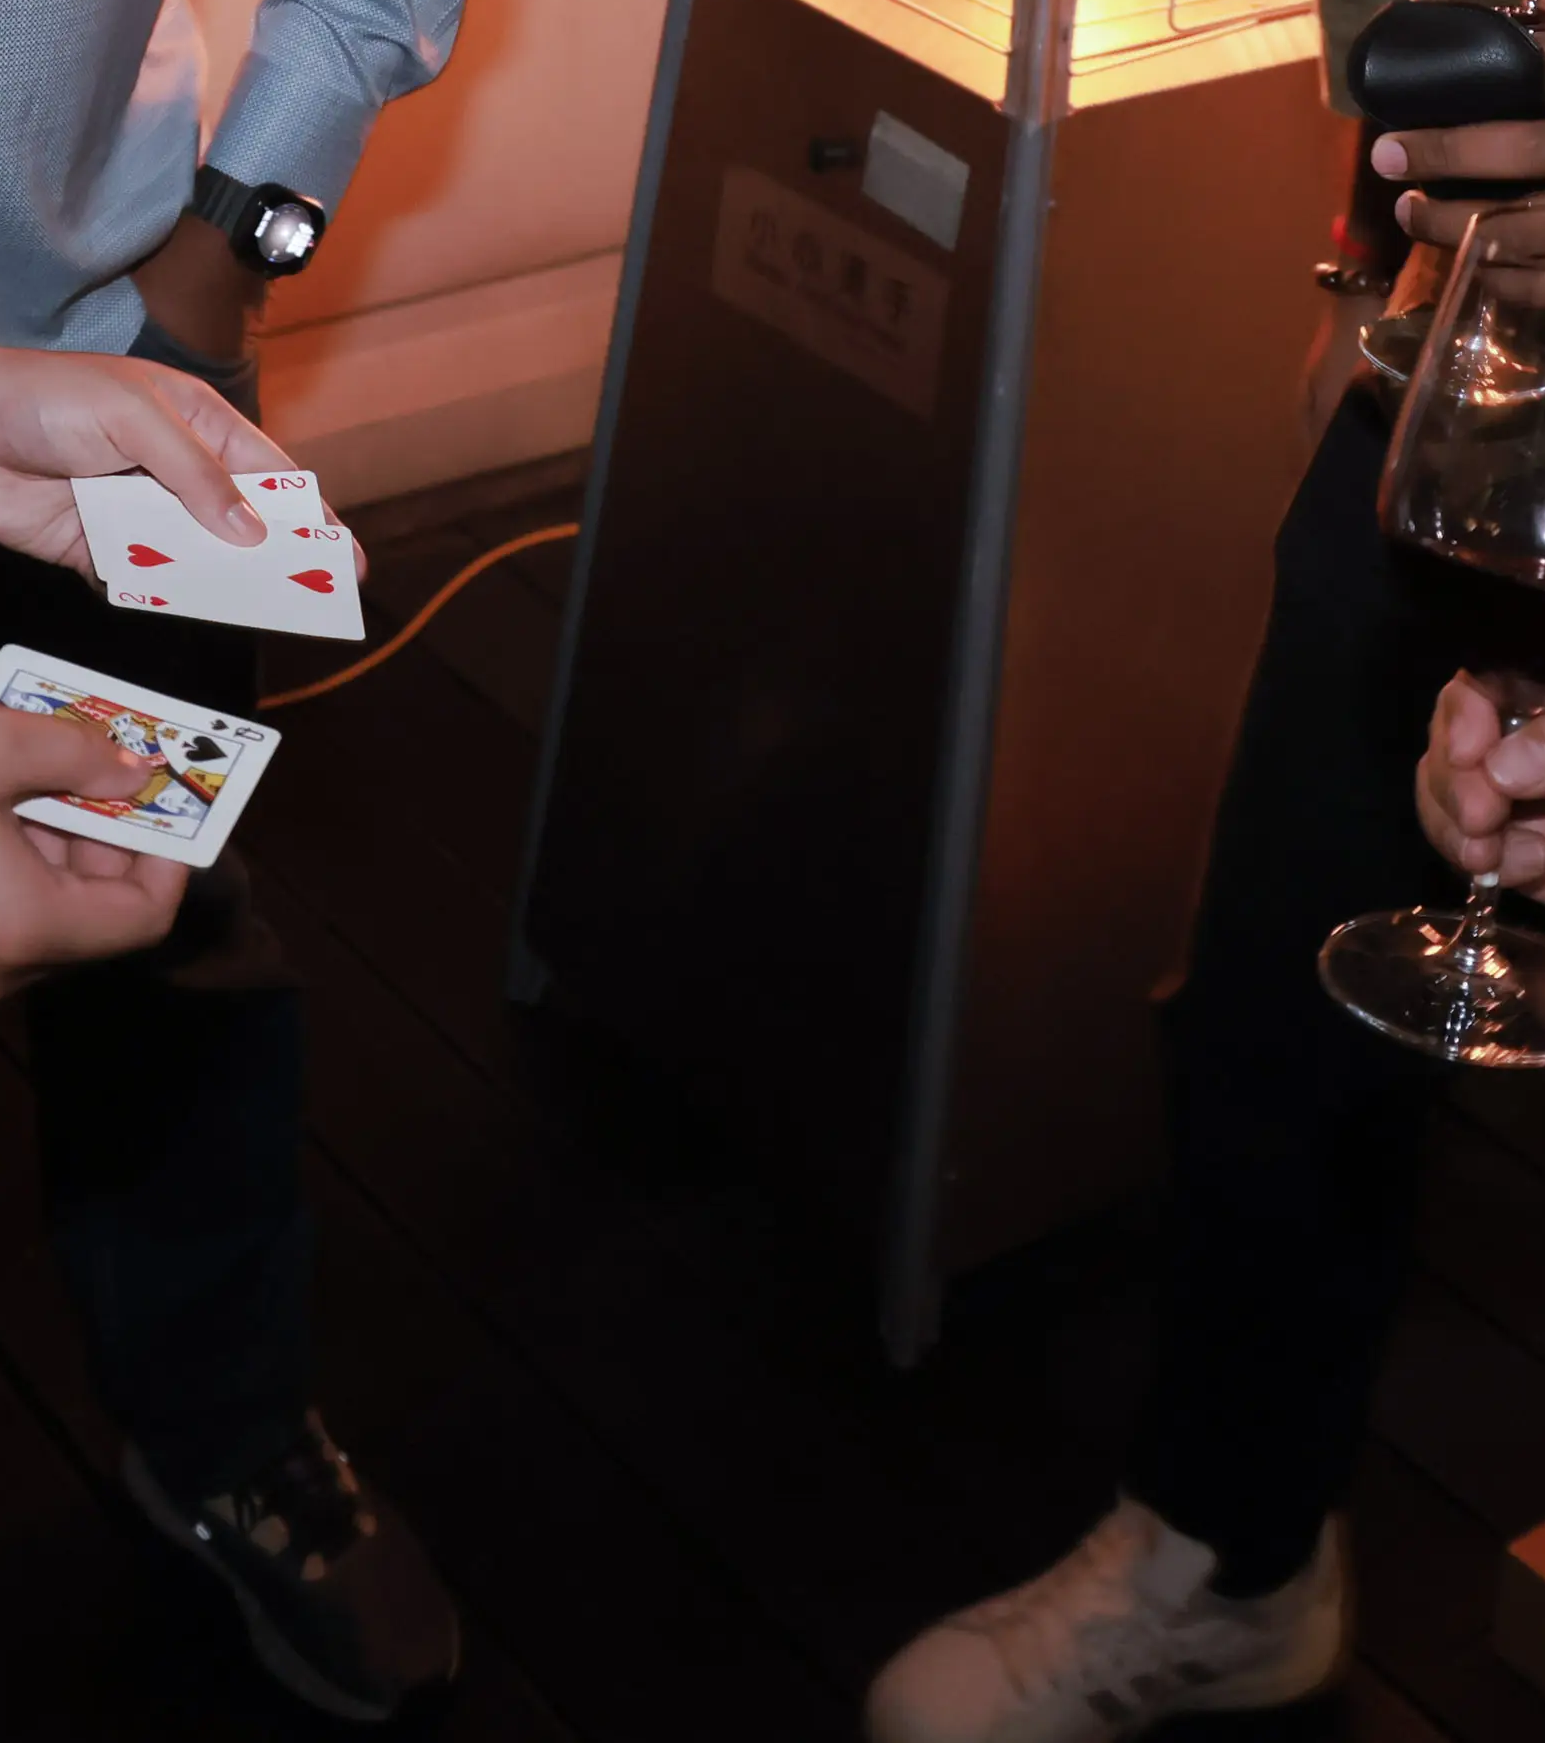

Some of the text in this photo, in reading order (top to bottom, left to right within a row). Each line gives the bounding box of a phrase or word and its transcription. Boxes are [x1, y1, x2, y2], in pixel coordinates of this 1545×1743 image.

[280, 476, 306, 490] 2
[314, 528, 340, 541] 2
[118, 592, 146, 605] 2
[234, 726, 265, 742] Q
